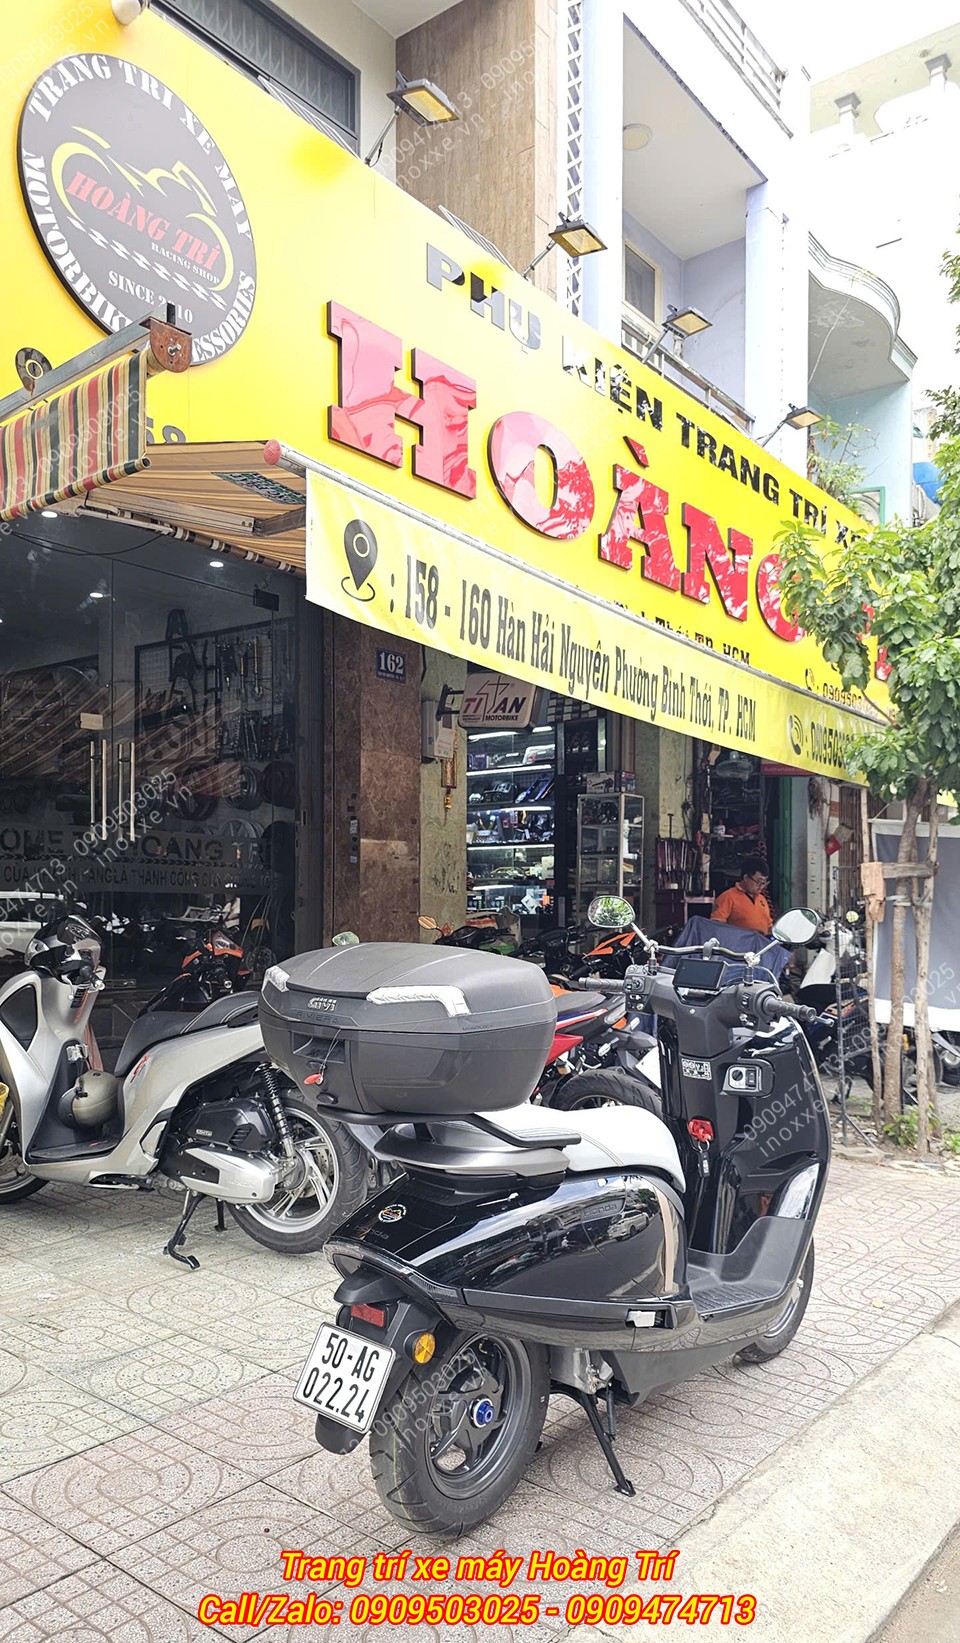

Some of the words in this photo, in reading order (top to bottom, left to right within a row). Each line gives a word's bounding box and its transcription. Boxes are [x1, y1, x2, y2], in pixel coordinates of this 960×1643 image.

[28, 54, 112, 122] TRANG
[179, 105, 217, 157] XE
[22, 148, 134, 333] MOTORBIK
[66, 171, 170, 242] HOÀNG
[171, 228, 222, 271] TRÍ
[151, 242, 191, 270] RACING
[192, 264, 220, 286] SHOP
[108, 270, 155, 306] SINCE
[158, 295, 193, 324] 210
[426, 241, 542, 355] PHỤ
[562, 334, 663, 433] KIỆN
[675, 411, 780, 507] TRANG
[789, 488, 828, 538] TRÍ
[378, 651, 405, 676] 162
[404, 554, 440, 630] 158
[459, 579, 492, 650] 160
[496, 594, 526, 663] Hàn
[530, 610, 555, 674] Hải
[559, 623, 610, 700] Nguyên
[613, 645, 659, 722] Phường
[718, 686, 732, 735] TP.
[736, 693, 757, 743] HCM
[463, 683, 526, 716] TITAN
[485, 714, 519, 722] MOTORBIKE
[296, 1011, 339, 1025] RIVIERA
[307, 996, 338, 1013] GIVI
[582, 1203, 618, 1217] Honda
[321, 1332, 380, 1383] 50-AG
[302, 1366, 370, 1423] 022.24
